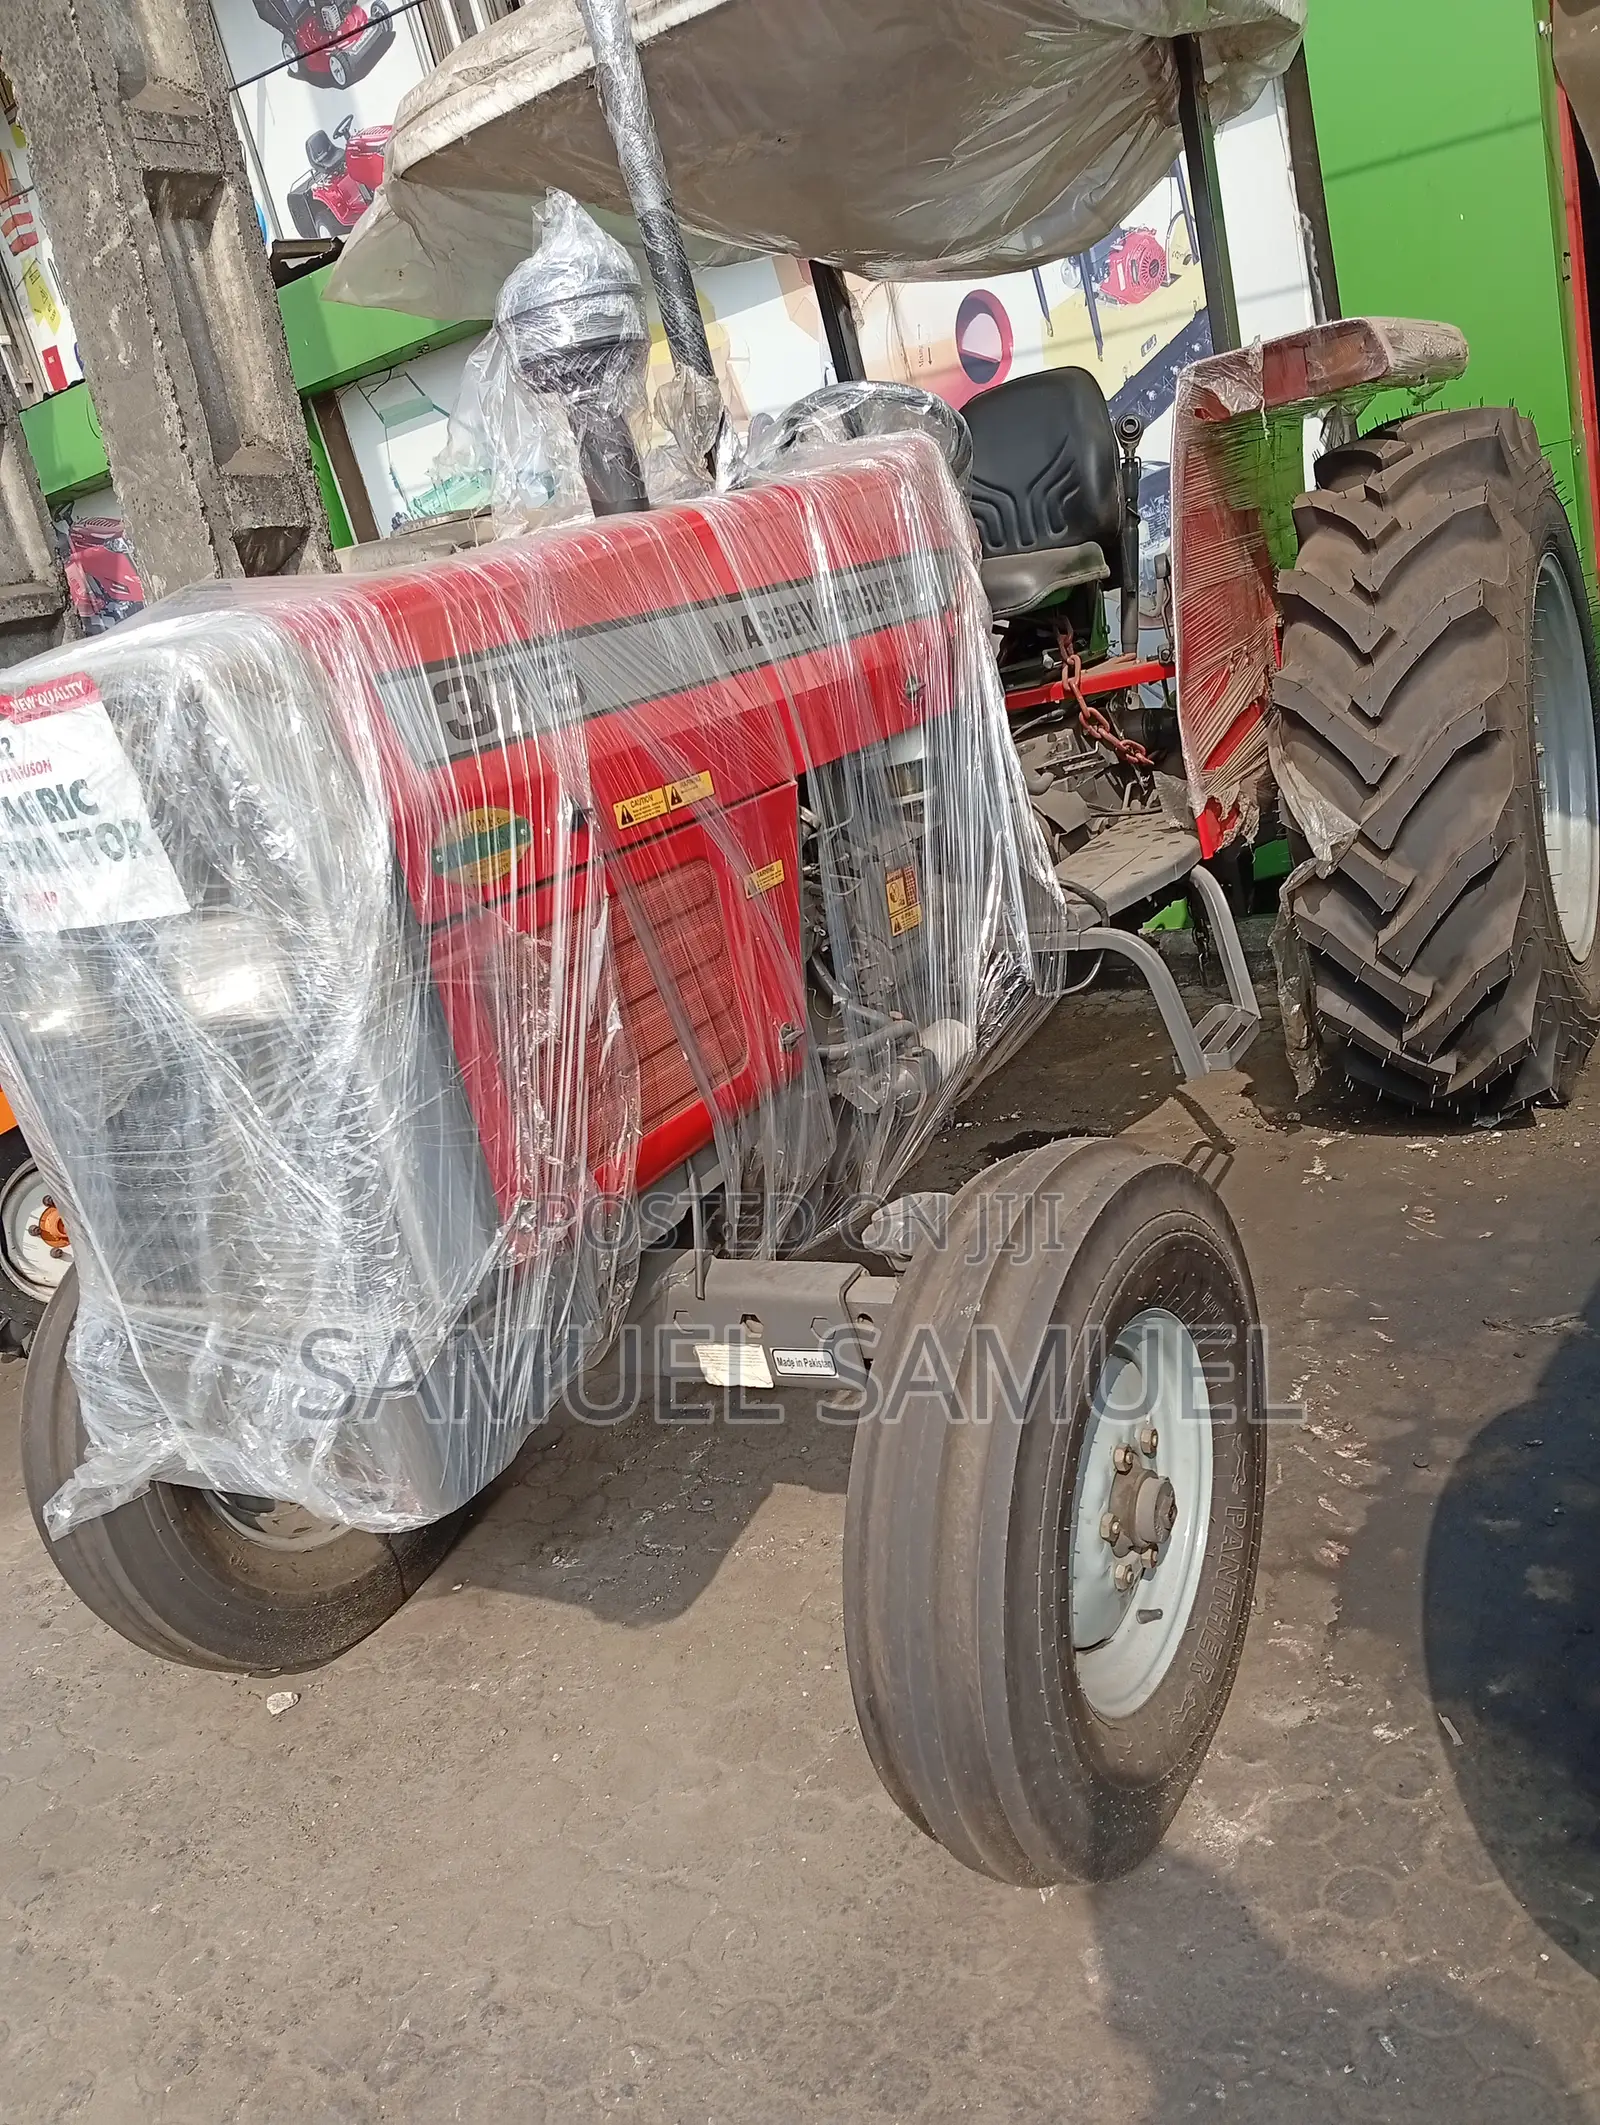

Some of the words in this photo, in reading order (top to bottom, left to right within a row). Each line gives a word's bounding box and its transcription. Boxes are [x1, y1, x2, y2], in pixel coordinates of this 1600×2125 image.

[714, 599, 819, 657] MASSEY
[9, 695, 36, 714] NEW
[37, 680, 86, 707] QUALITY
[0, 778, 100, 830] AGRIC
[630, 794, 654, 809] CAUTION
[0, 818, 155, 875] TRATOR
[776, 1356, 795, 1369] Made
[796, 1357, 803, 1367] in
[804, 1357, 833, 1369] Pakistan
[1190, 1505, 1248, 1685] PANTHER
